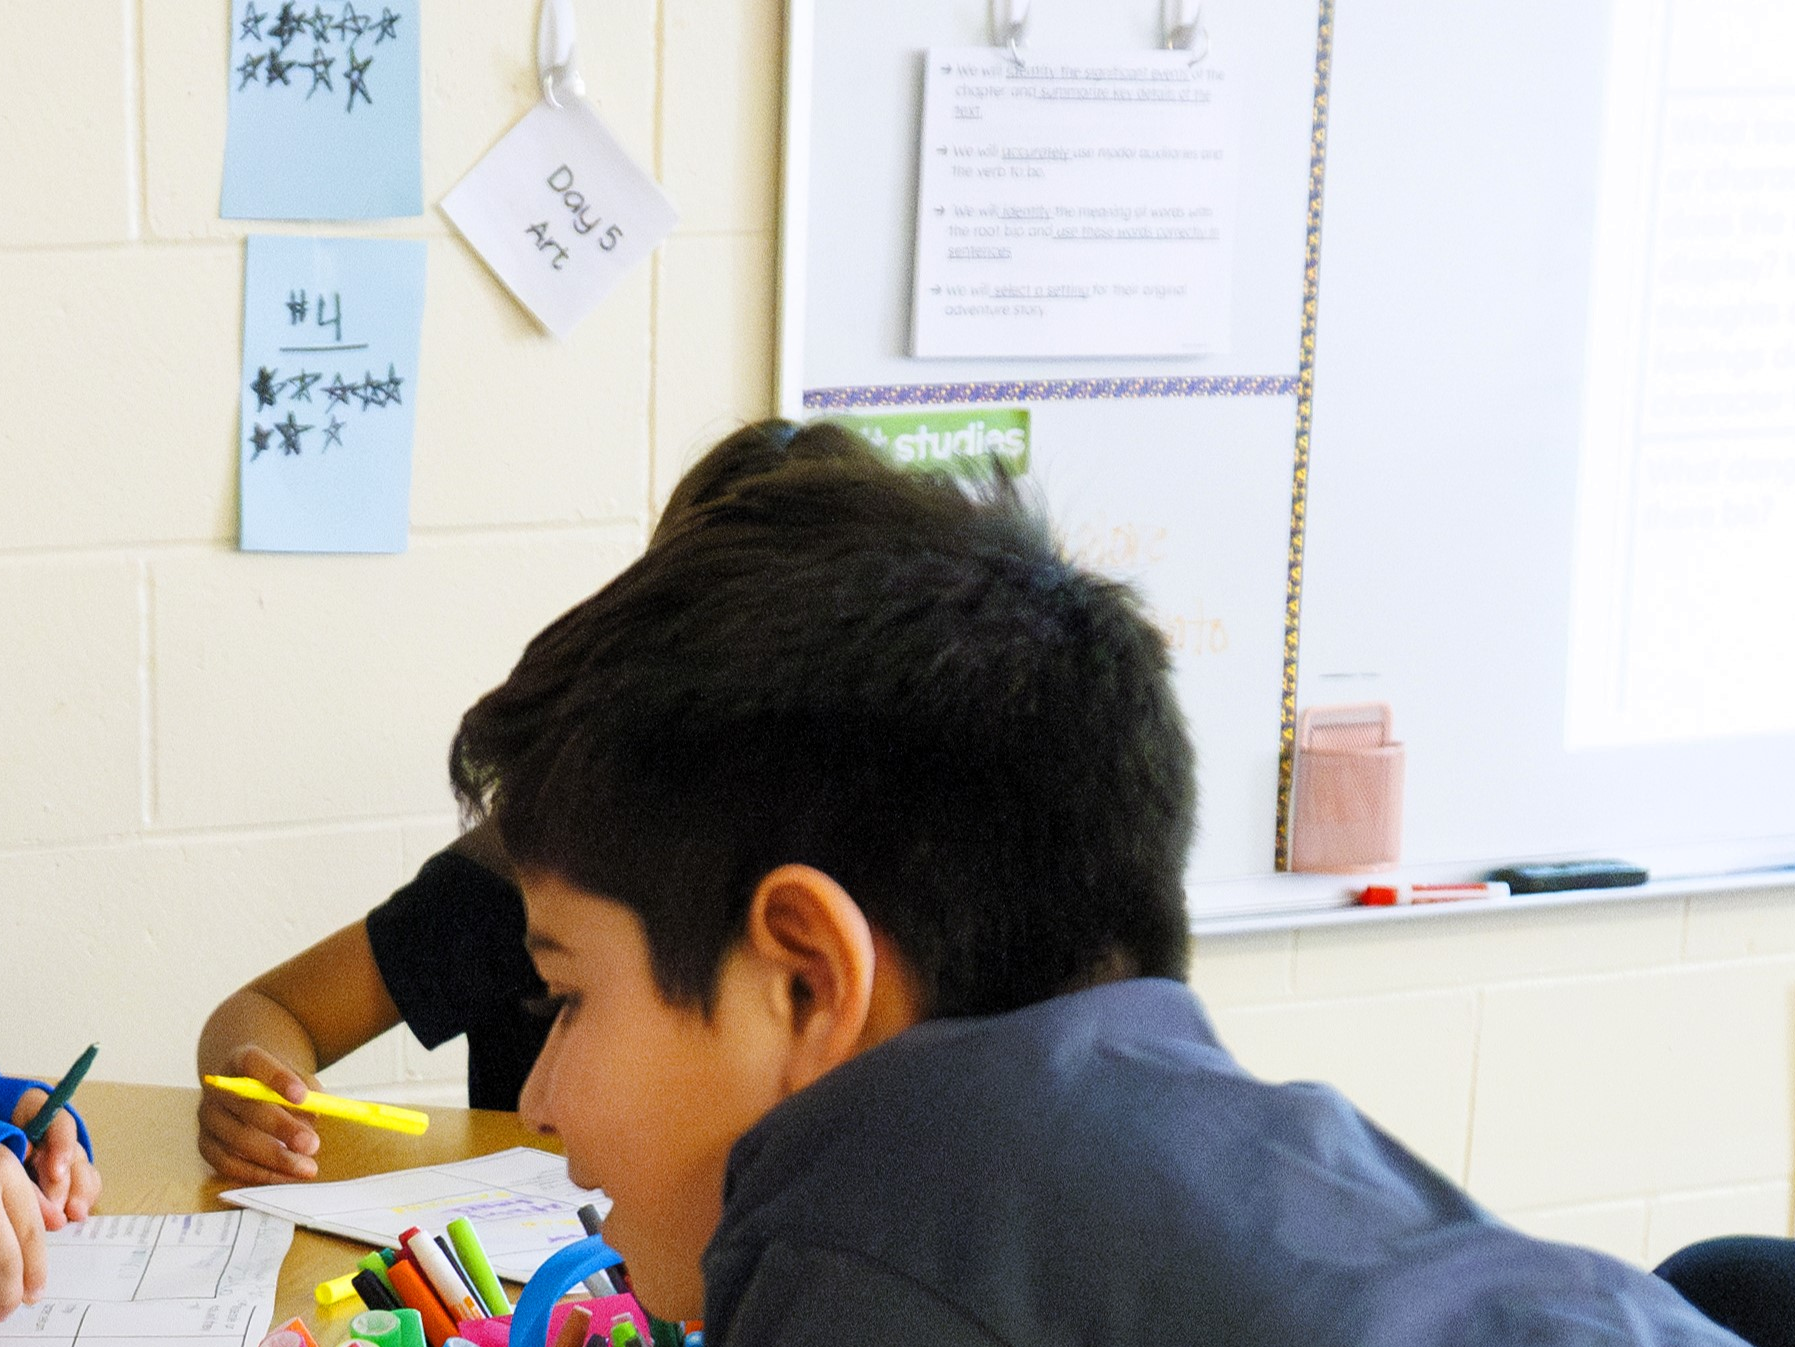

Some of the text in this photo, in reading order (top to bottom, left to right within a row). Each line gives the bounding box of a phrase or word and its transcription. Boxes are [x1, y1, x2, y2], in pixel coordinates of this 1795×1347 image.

[1011, 86, 1036, 97] and
[1194, 88, 1211, 100] the
[954, 146, 973, 157] We
[977, 146, 998, 158] will
[953, 166, 972, 178] the
[977, 166, 1004, 178] verb
[1010, 166, 1024, 178] to
[546, 163, 624, 252] Day 5
[953, 206, 973, 218] We
[977, 206, 997, 218] will
[1002, 206, 1050, 220] identify
[1054, 206, 1075, 218] the
[1135, 206, 1147, 218] of
[1151, 206, 1185, 218] words
[949, 226, 970, 238] the
[973, 226, 999, 237] root
[1029, 226, 1052, 237] and
[1057, 227, 1078, 238] use
[1082, 226, 1114, 238] these
[524, 220, 570, 270] Art
[946, 284, 965, 296] We
[970, 284, 989, 296] will
[994, 284, 1031, 297] select
[1047, 284, 1089, 299] setting
[1092, 284, 1107, 296] for
[1112, 284, 1137, 296] their
[1142, 284, 1186, 298] original
[287, 290, 341, 341] #4
[946, 304, 1009, 316] adventure
[894, 420, 1026, 463] studies
